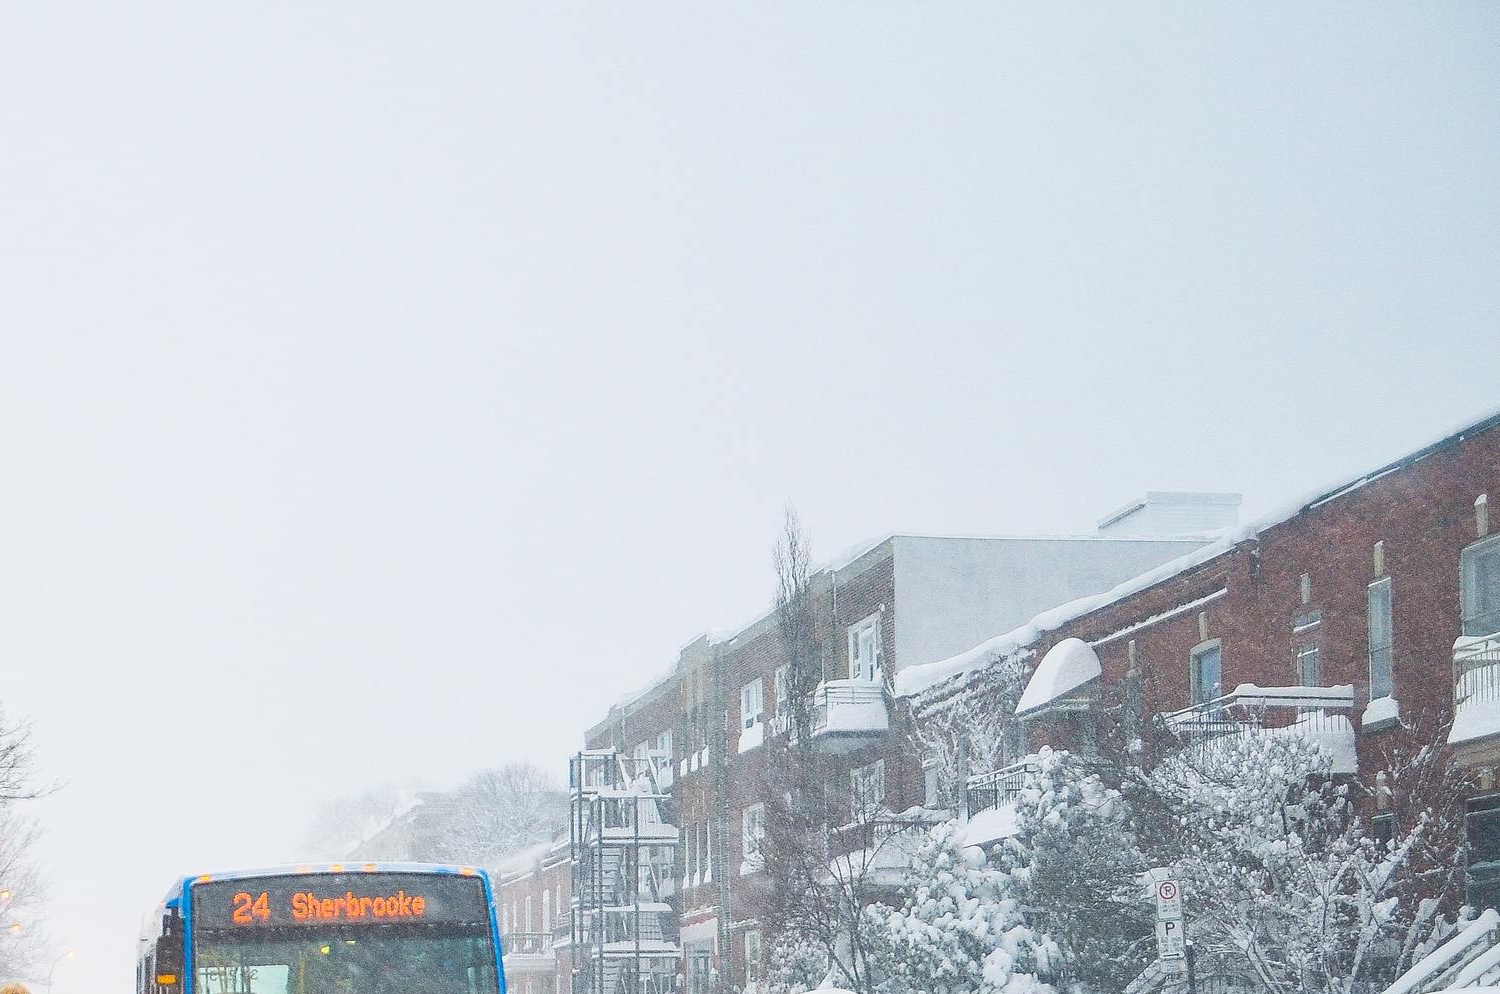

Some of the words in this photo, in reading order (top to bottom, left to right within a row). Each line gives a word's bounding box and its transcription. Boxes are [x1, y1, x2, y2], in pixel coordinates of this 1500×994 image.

[232, 892, 271, 924] 24
[292, 889, 426, 922] Sherbrooke
[1165, 921, 1175, 935] P
